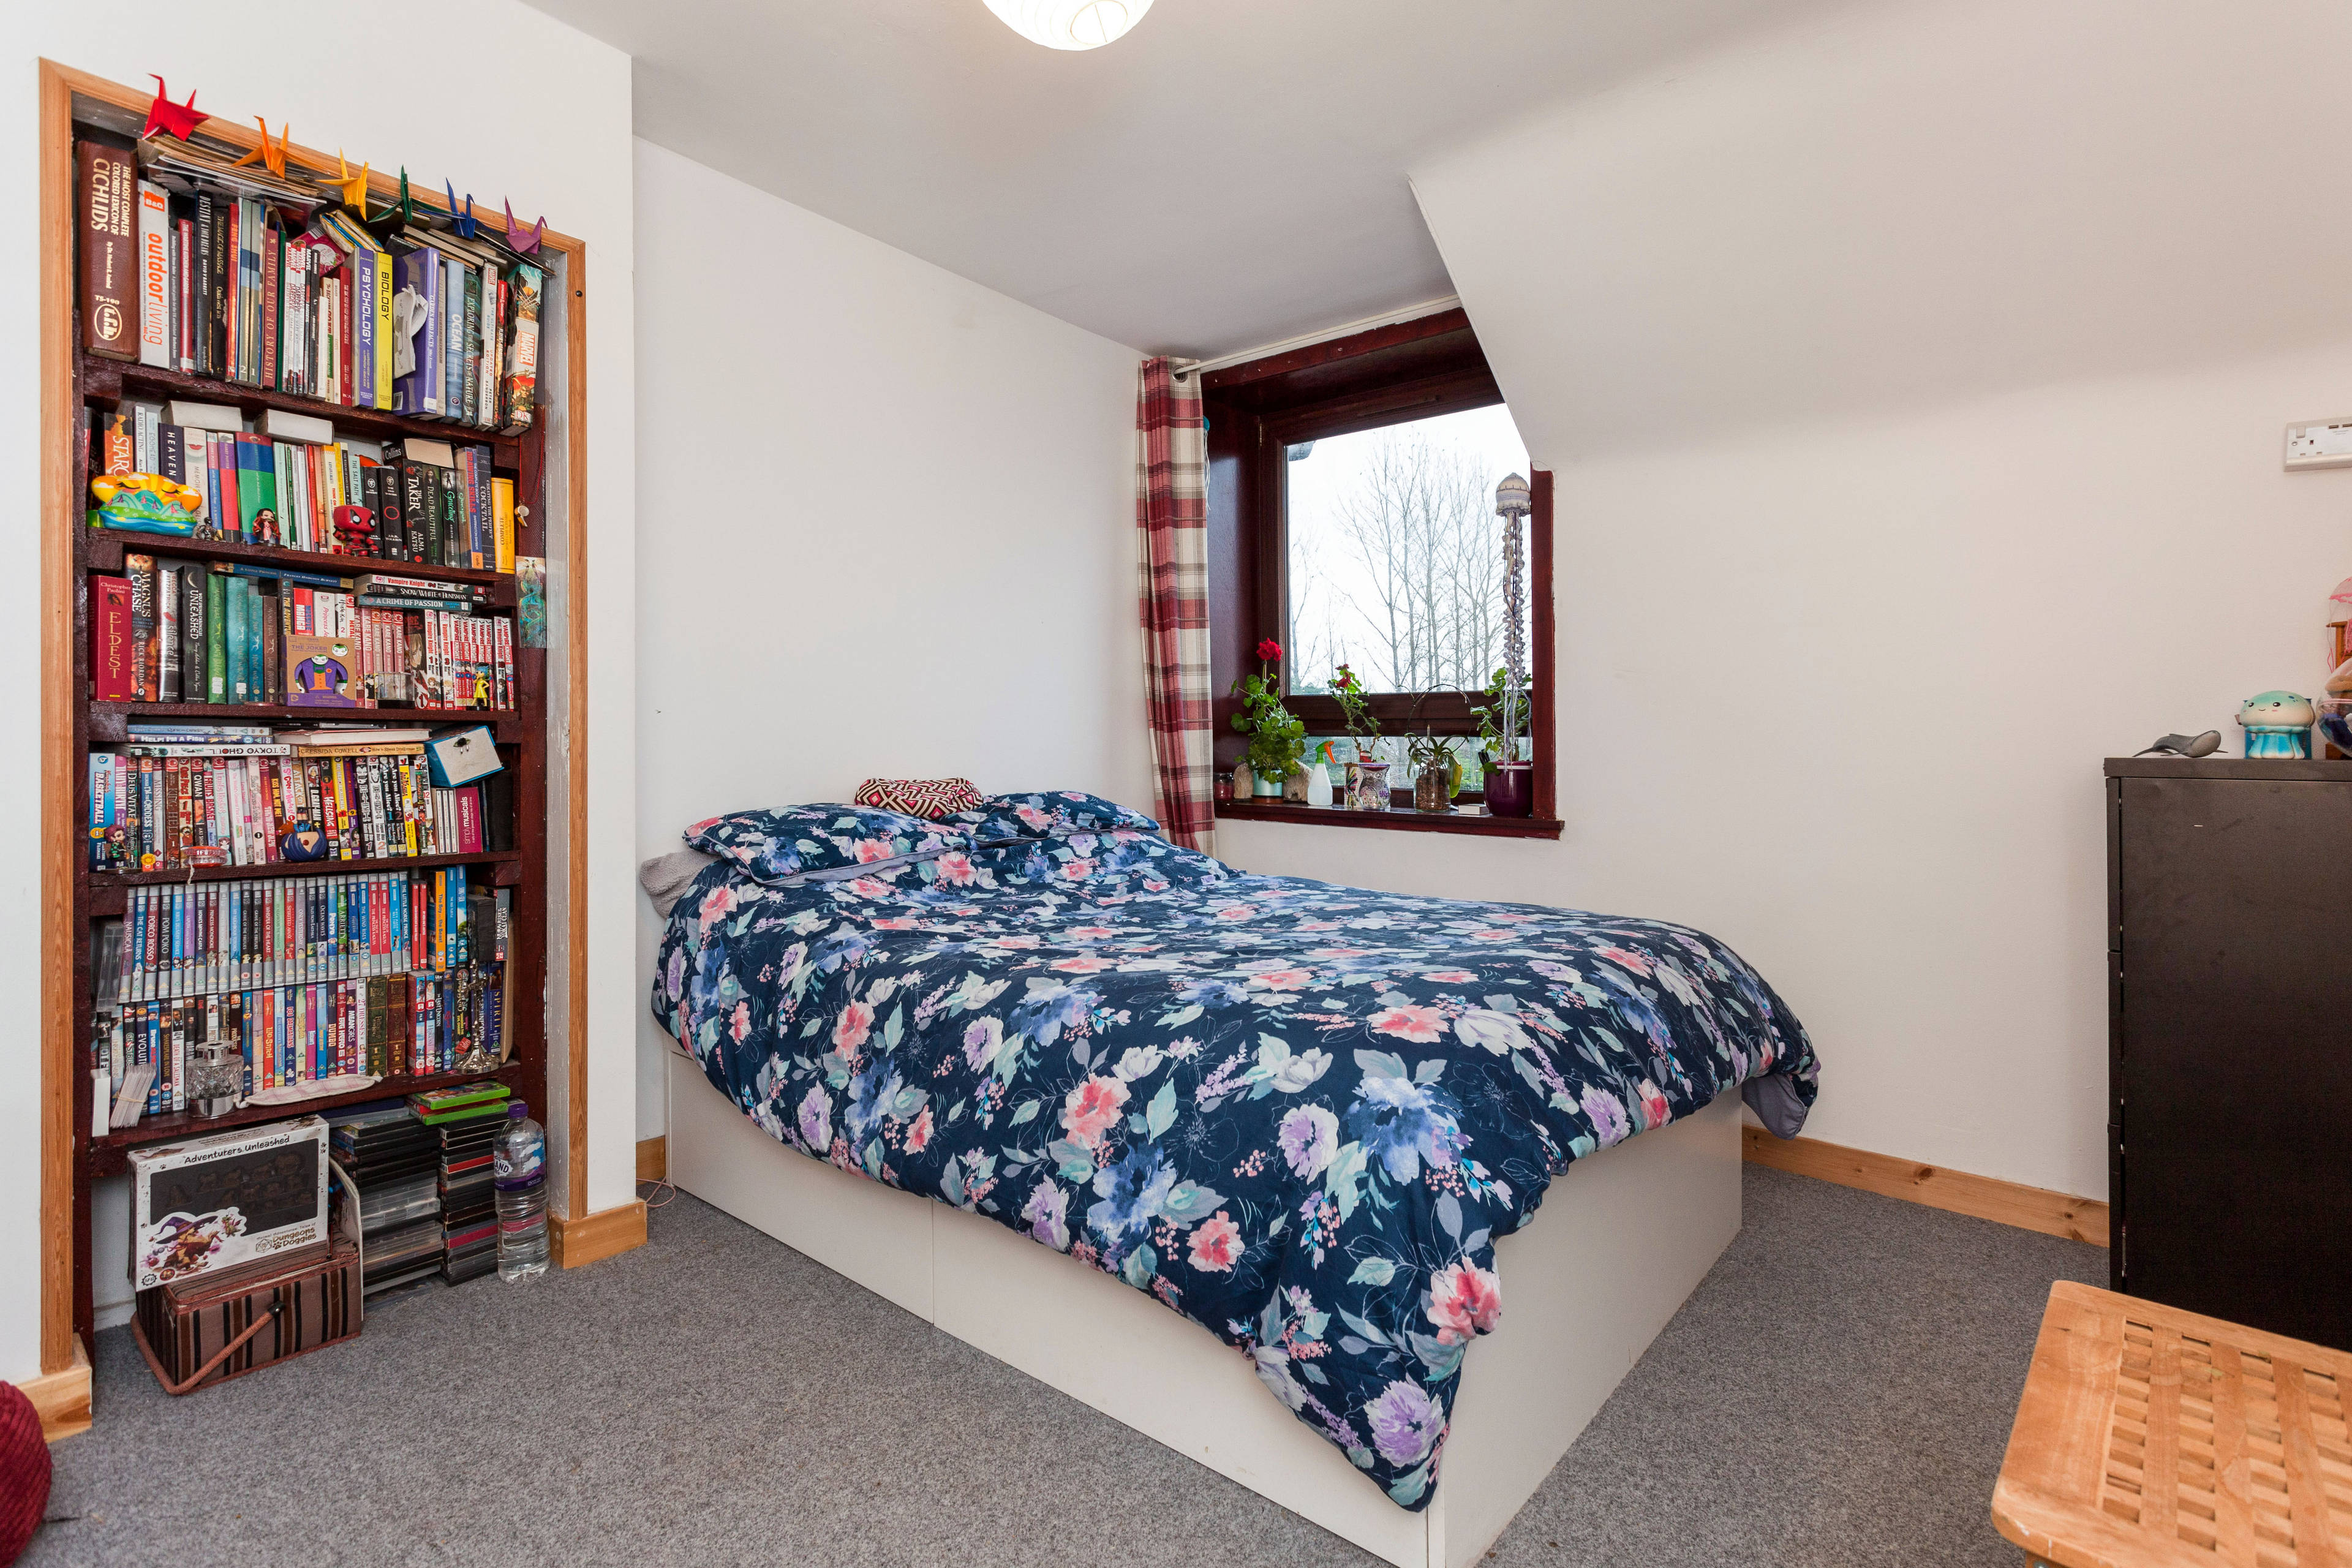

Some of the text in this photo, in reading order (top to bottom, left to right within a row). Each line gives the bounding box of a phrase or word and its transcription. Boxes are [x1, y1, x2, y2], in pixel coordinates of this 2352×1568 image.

[91, 158, 110, 231] CICHLIDS
[110, 162, 121, 235] COLORED LEXICON OF
[121, 179, 130, 200] MOST
[144, 199, 163, 209] B&Q
[121, 201, 129, 236] COMPLETE
[268, 250, 276, 285] FAMILY
[95, 295, 119, 305] TS-190
[362, 267, 371, 345] PSYCHOLOGY
[266, 317, 274, 330] OF
[451, 314, 462, 351] OCEAN
[520, 333, 534, 364] MARVEL
[516, 411, 530, 422] DK
[167, 432, 176, 476] HEAVEN
[385, 448, 402, 460] Collins
[408, 477, 421, 512] TAKER
[443, 491, 455, 523] Graceling
[132, 575, 141, 612] CHASE
[140, 571, 151, 617] MAGNUS
[190, 590, 198, 639] UNLEASHED
[296, 605, 305, 630] MANGA
[108, 612, 122, 679] ELDEST
[166, 625, 177, 655] silence
[361, 616, 372, 650] KARE KANO
[95, 772, 104, 824] BASKETBALL
[128, 794, 137, 818] VITAE
[168, 788, 178, 839] KING HELL
[204, 778, 215, 821] FRUITS BASKET
[324, 796, 334, 826] HELLSING
[184, 1147, 242, 1164] Adventurers
[244, 1136, 290, 1152] Unleashed
[273, 1227, 315, 1243] Dungeons
[283, 1234, 317, 1247] Doggies
